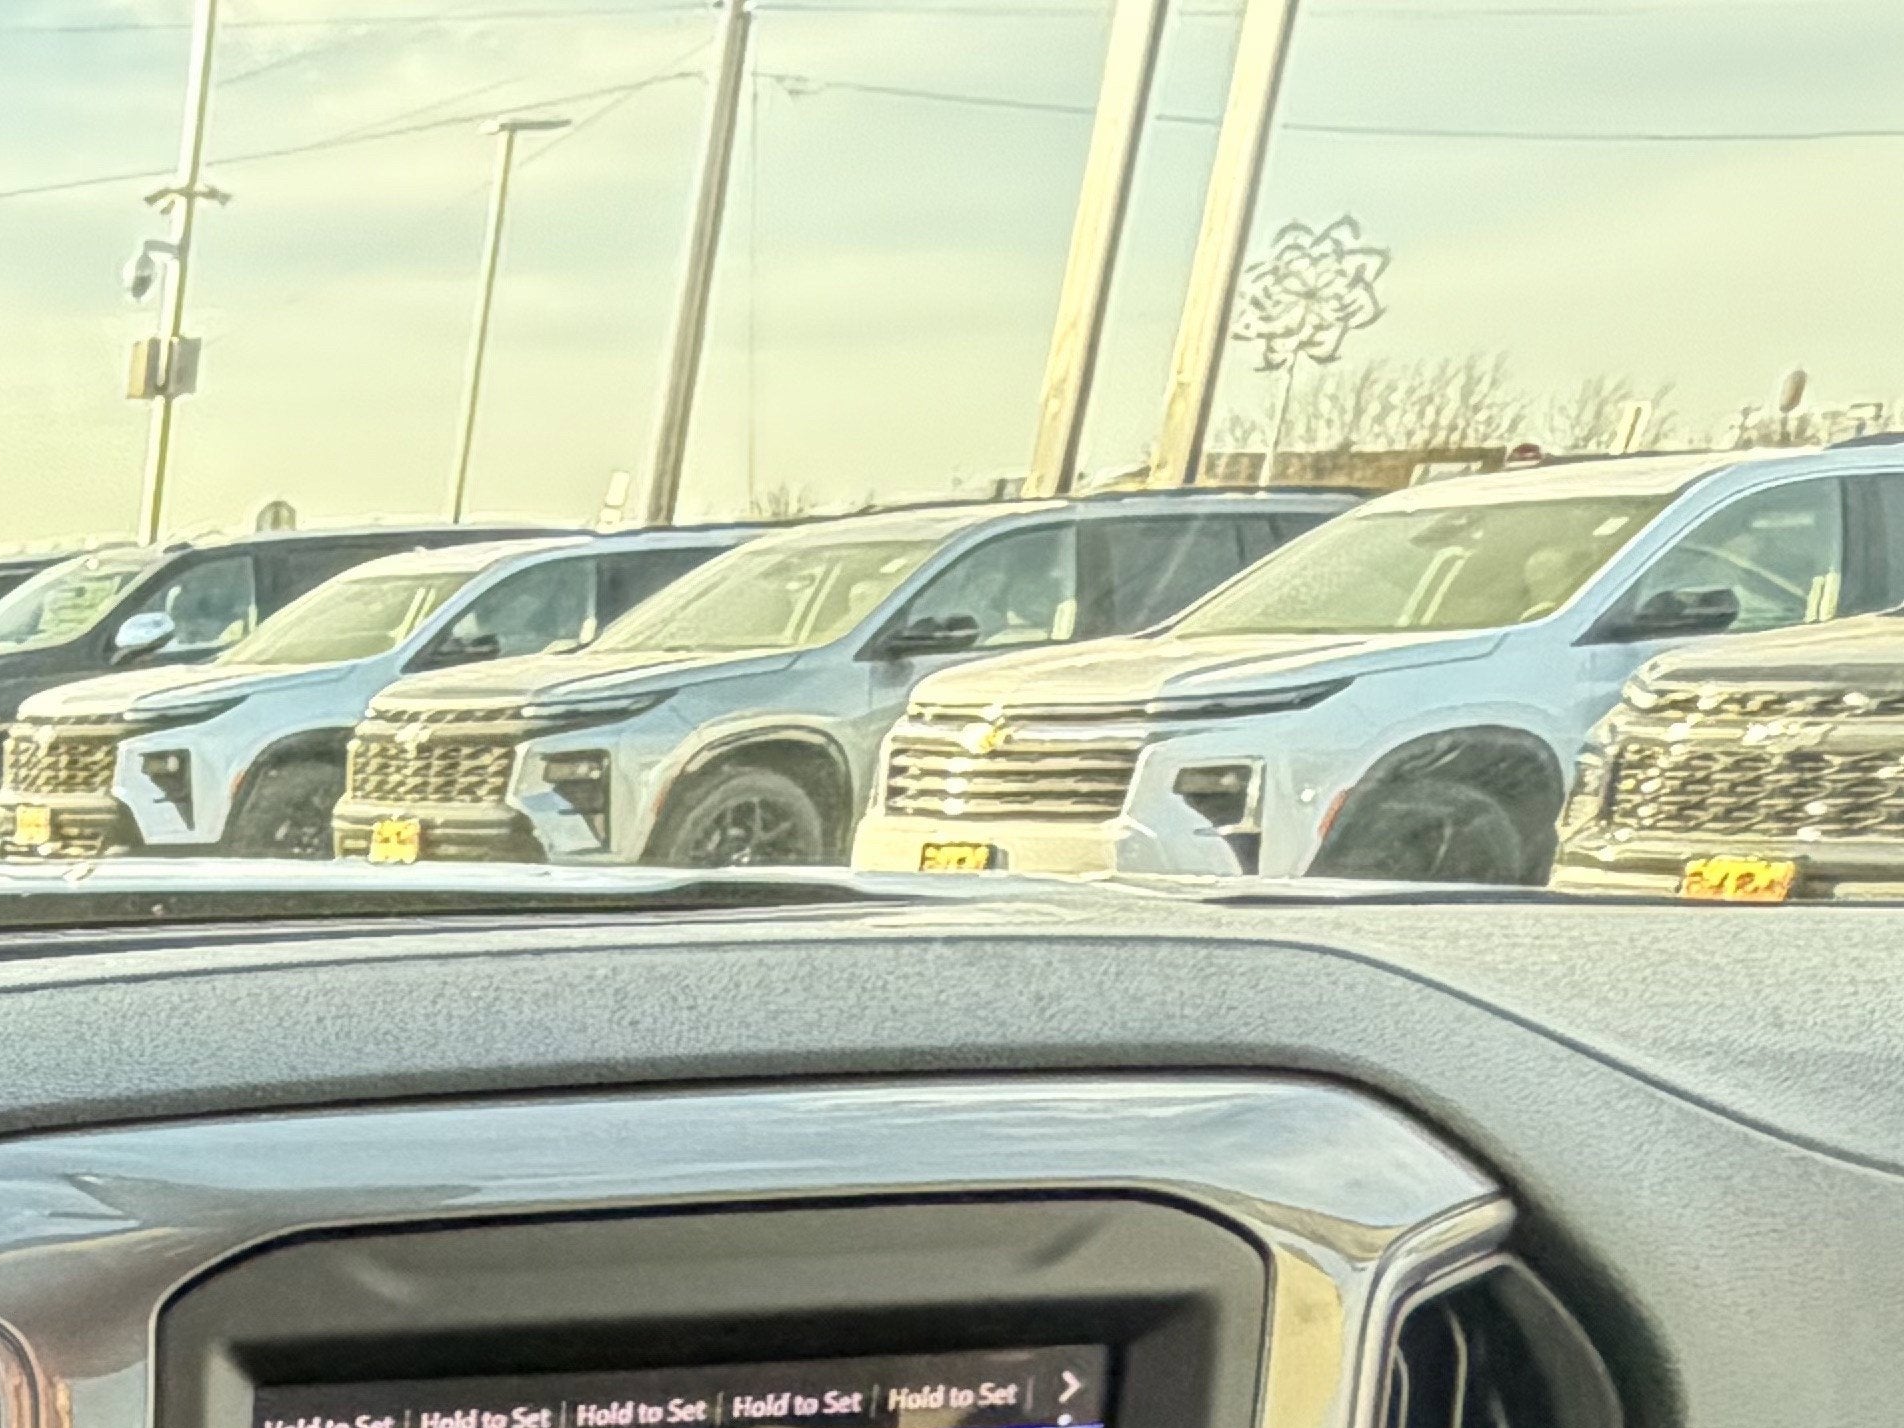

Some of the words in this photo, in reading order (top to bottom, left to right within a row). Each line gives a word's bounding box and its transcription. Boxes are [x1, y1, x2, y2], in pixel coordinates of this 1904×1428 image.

[732, 1394, 789, 1418] Hold
[793, 1395, 818, 1416] to
[823, 1391, 862, 1413] Set
[888, 1385, 945, 1410] Hold
[949, 1387, 974, 1407] to
[978, 1383, 1017, 1405] Set
[576, 1402, 633, 1427] Hold
[637, 1403, 663, 1423] to
[667, 1398, 707, 1421] Set
